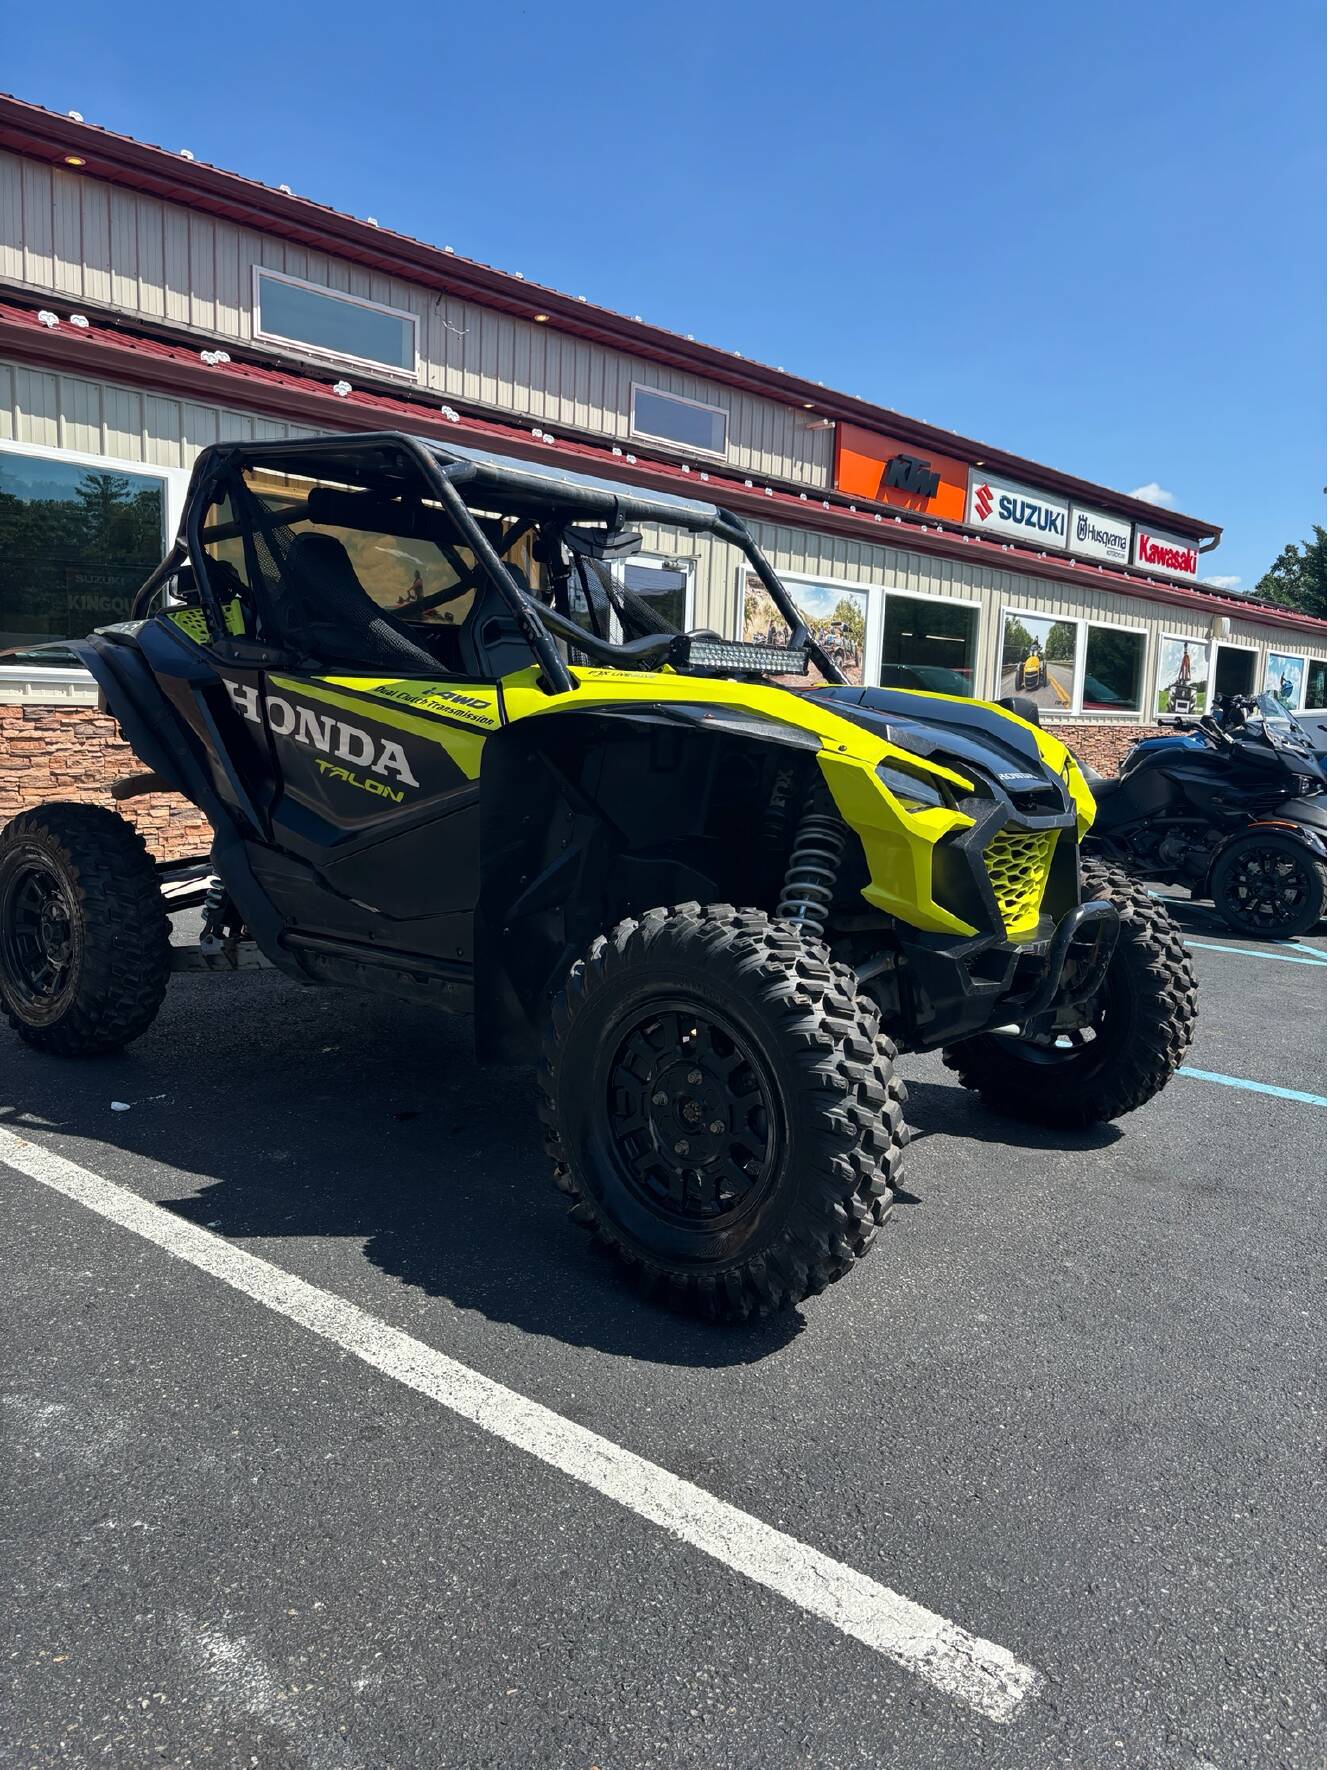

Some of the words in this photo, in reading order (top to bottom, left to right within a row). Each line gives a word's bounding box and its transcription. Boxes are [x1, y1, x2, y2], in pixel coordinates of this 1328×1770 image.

[880, 454, 941, 499] KTM
[998, 495, 1065, 536] SUZUKI
[1087, 524, 1127, 550] Husqvarna
[1139, 534, 1198, 575] Kawasaki
[74, 574, 126, 586] SUZUKI
[373, 685, 396, 698] Dual
[397, 690, 428, 705] Clutch
[428, 699, 495, 726] Transmission
[222, 679, 420, 788] HONDA
[315, 758, 405, 804] TALON
